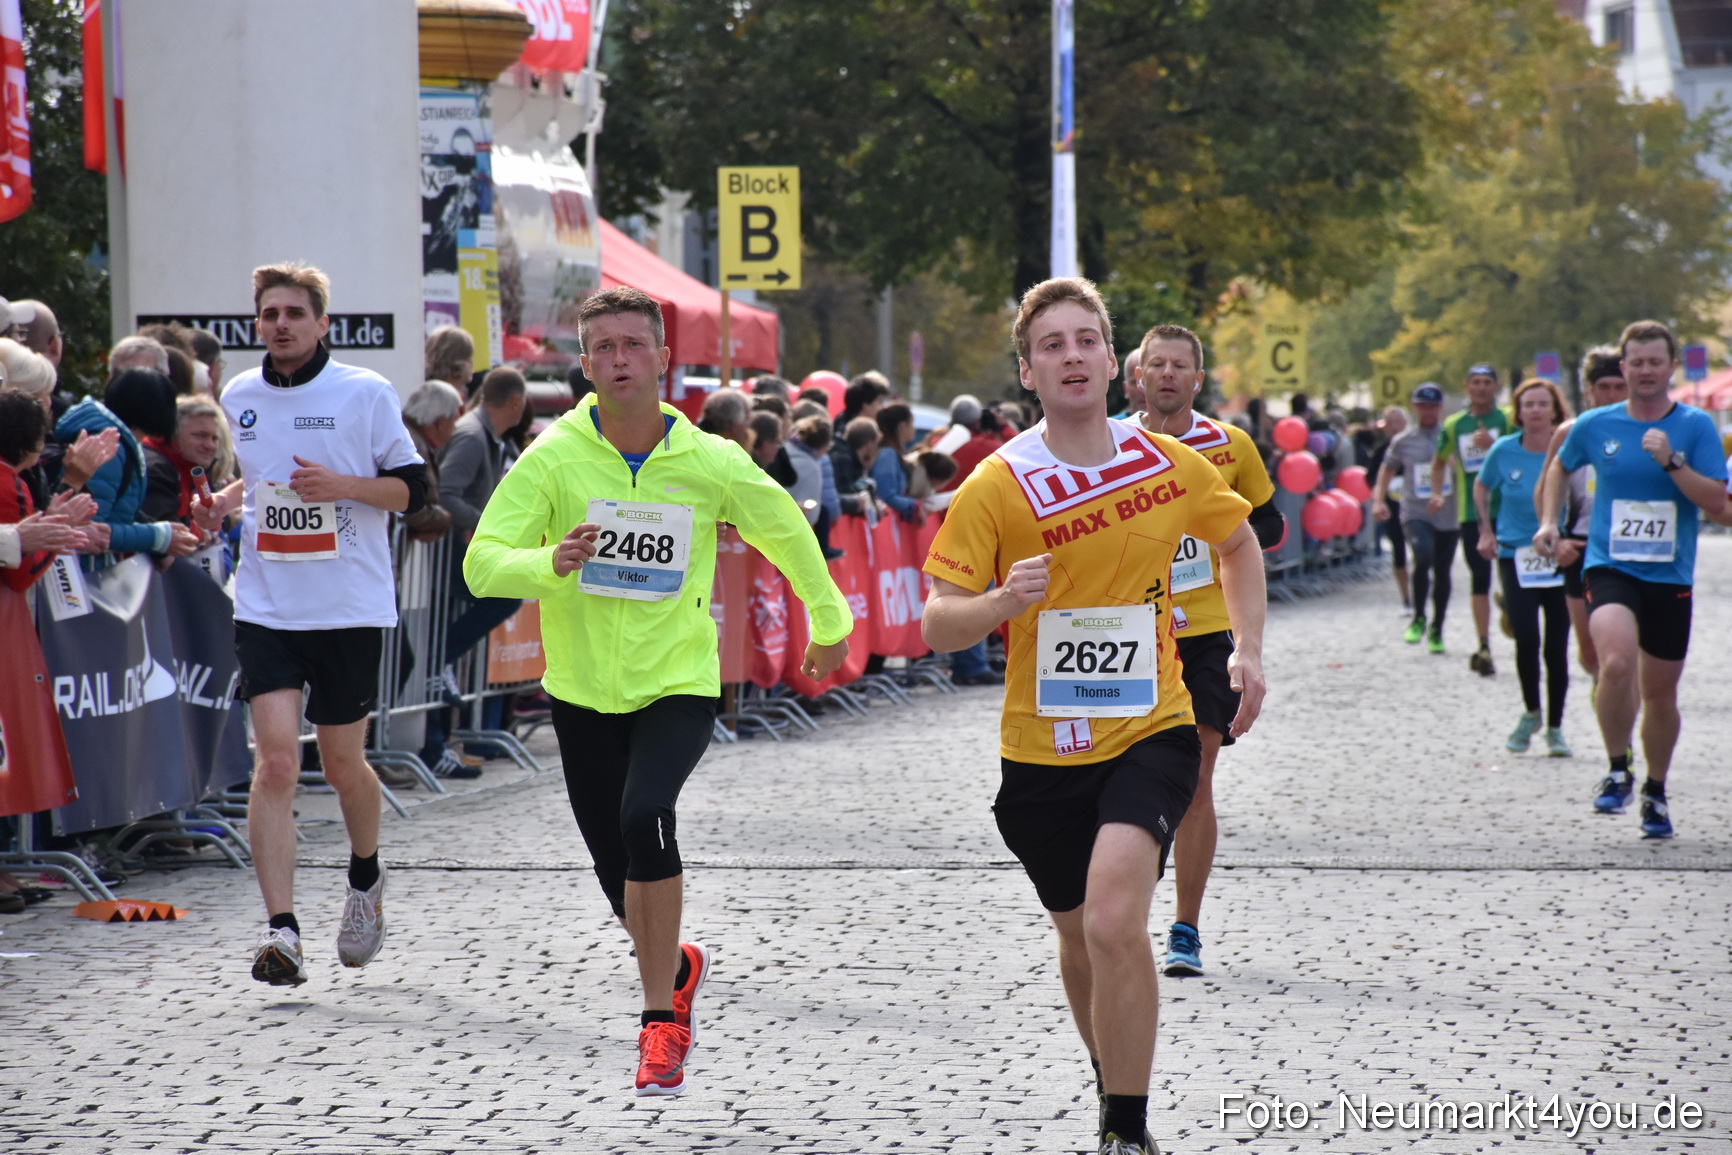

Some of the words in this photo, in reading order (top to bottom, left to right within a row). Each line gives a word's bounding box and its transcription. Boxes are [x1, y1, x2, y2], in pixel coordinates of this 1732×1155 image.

[728, 173, 790, 194] Block
[741, 205, 779, 262] B
[192, 319, 265, 346] MIN
[1271, 341, 1294, 373] C
[1382, 375, 1399, 398] D
[294, 417, 335, 427] BOCK
[265, 506, 322, 530] 8005
[626, 510, 663, 521] BOCK
[1041, 508, 1111, 550] MAX
[1114, 480, 1187, 521] BÖGL
[1620, 519, 1666, 538] 2747
[597, 530, 674, 564] 2468
[55, 559, 72, 593] swn
[617, 570, 649, 583] Viktor
[1083, 617, 1122, 627] BOCK
[1055, 641, 1139, 674] 2627
[1073, 686, 1120, 698] Thomas
